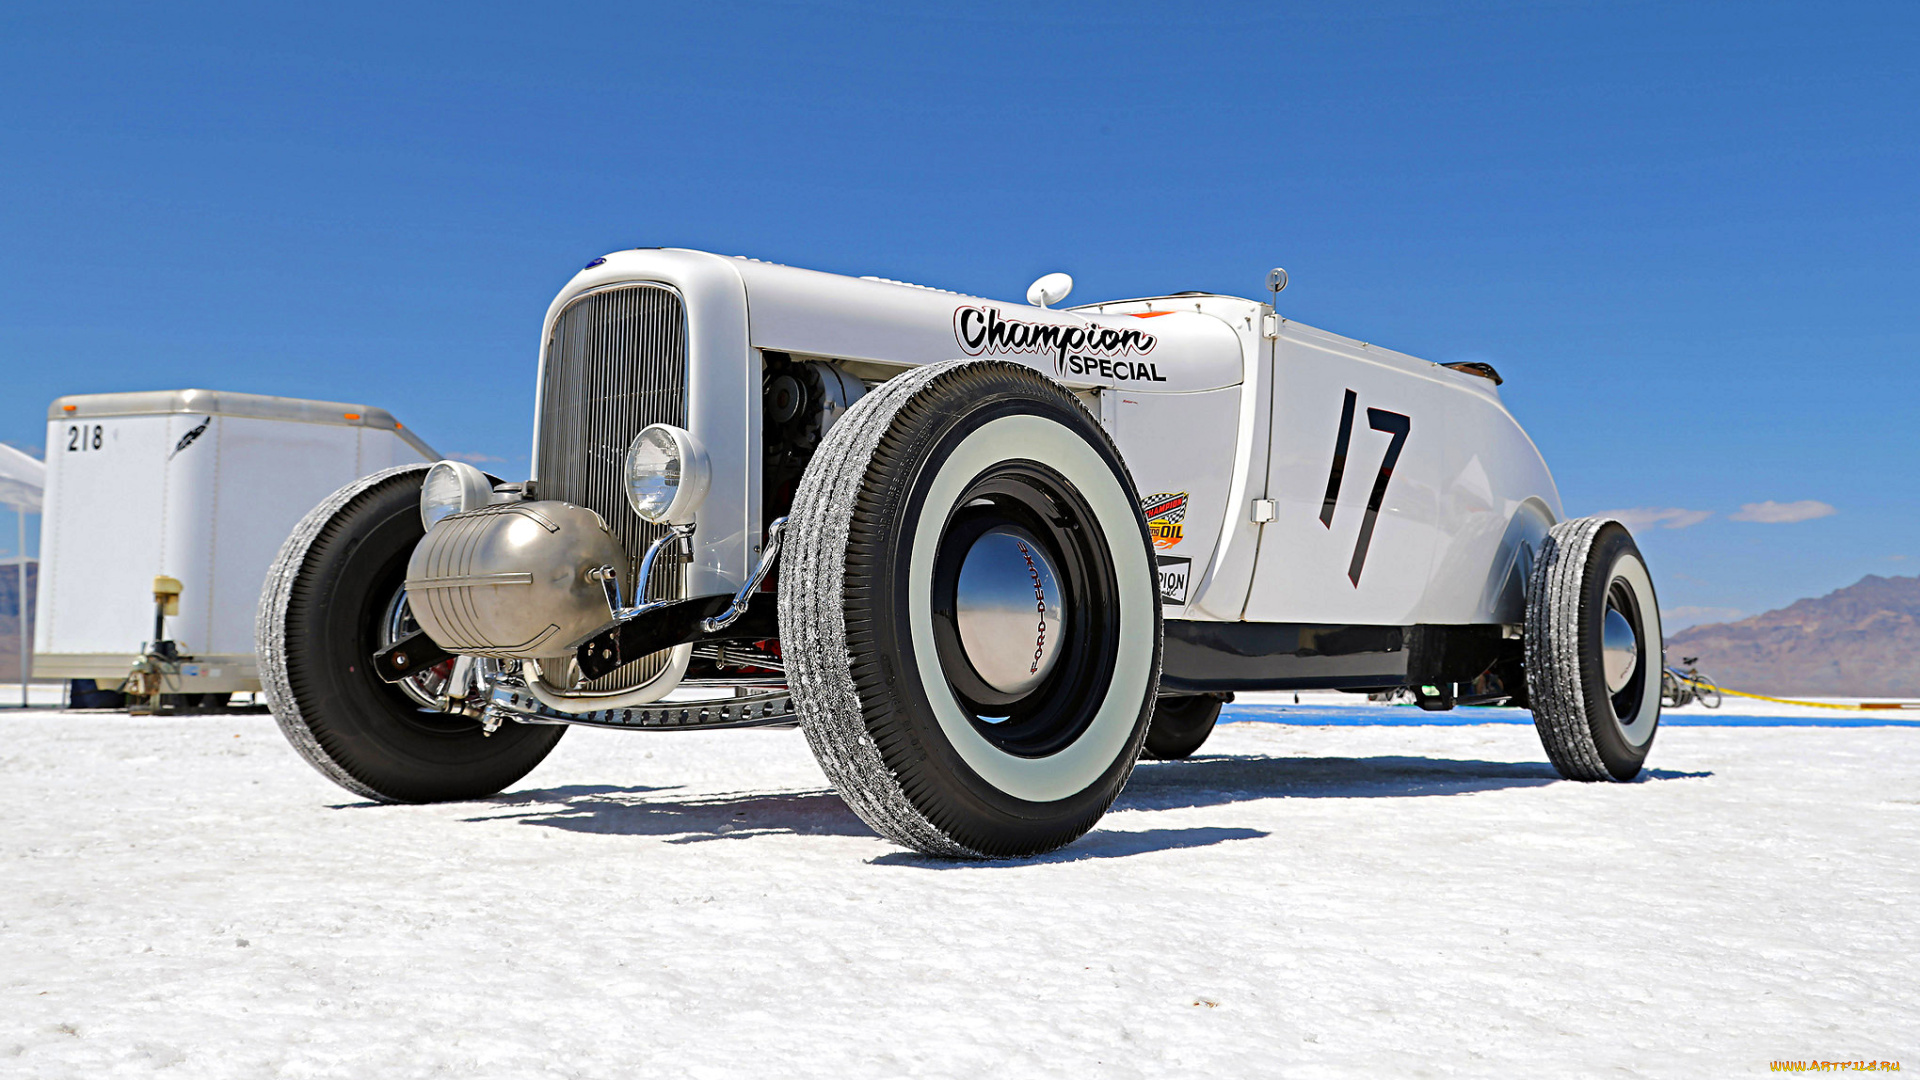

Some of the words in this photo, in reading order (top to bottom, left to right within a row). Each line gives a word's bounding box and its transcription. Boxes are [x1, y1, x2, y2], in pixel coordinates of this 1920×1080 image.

[960, 307, 1155, 376] Champion
[1069, 355, 1167, 382] SPECIAL
[68, 424, 103, 451] 218
[1319, 387, 1411, 590] 17
[1160, 525, 1184, 539] OIL
[1158, 572, 1185, 590] PION
